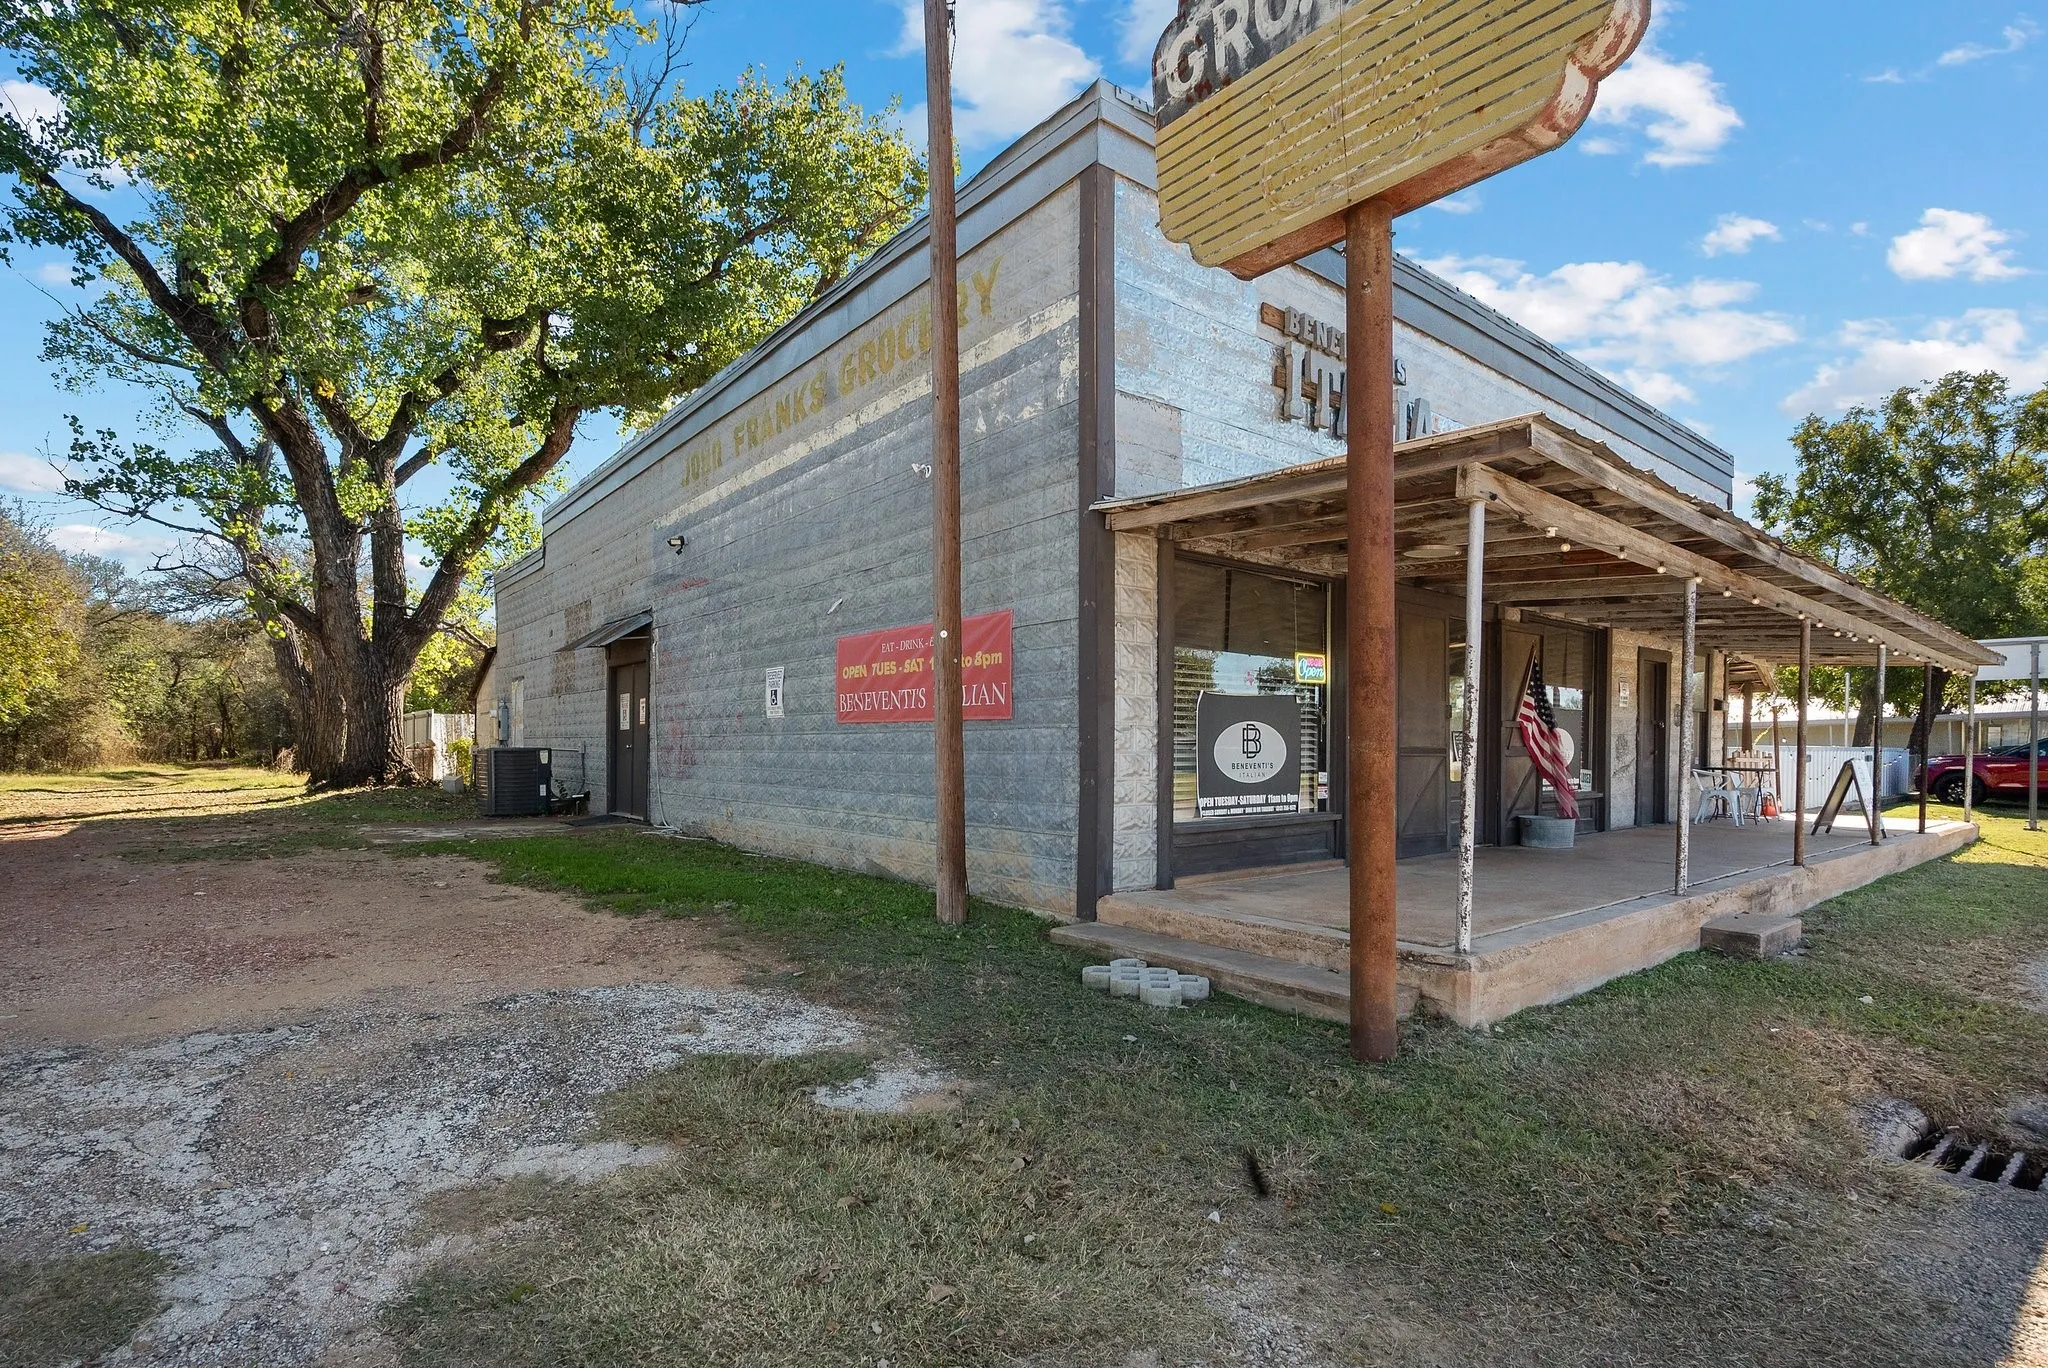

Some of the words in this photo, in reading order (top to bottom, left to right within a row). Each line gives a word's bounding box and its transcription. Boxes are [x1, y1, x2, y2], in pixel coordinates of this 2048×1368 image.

[733, 368, 826, 457] FRANKS
[881, 642, 895, 653] EAT
[899, 638, 925, 651] DRINK
[842, 664, 868, 680] OPEN
[872, 660, 897, 676] TUES
[903, 658, 925, 674] SAT
[961, 655, 972, 668] to
[974, 650, 1003, 669] 8pm
[839, 687, 926, 713] BENEVENTI'S
[1231, 762, 1274, 770] BENEVENTI'S
